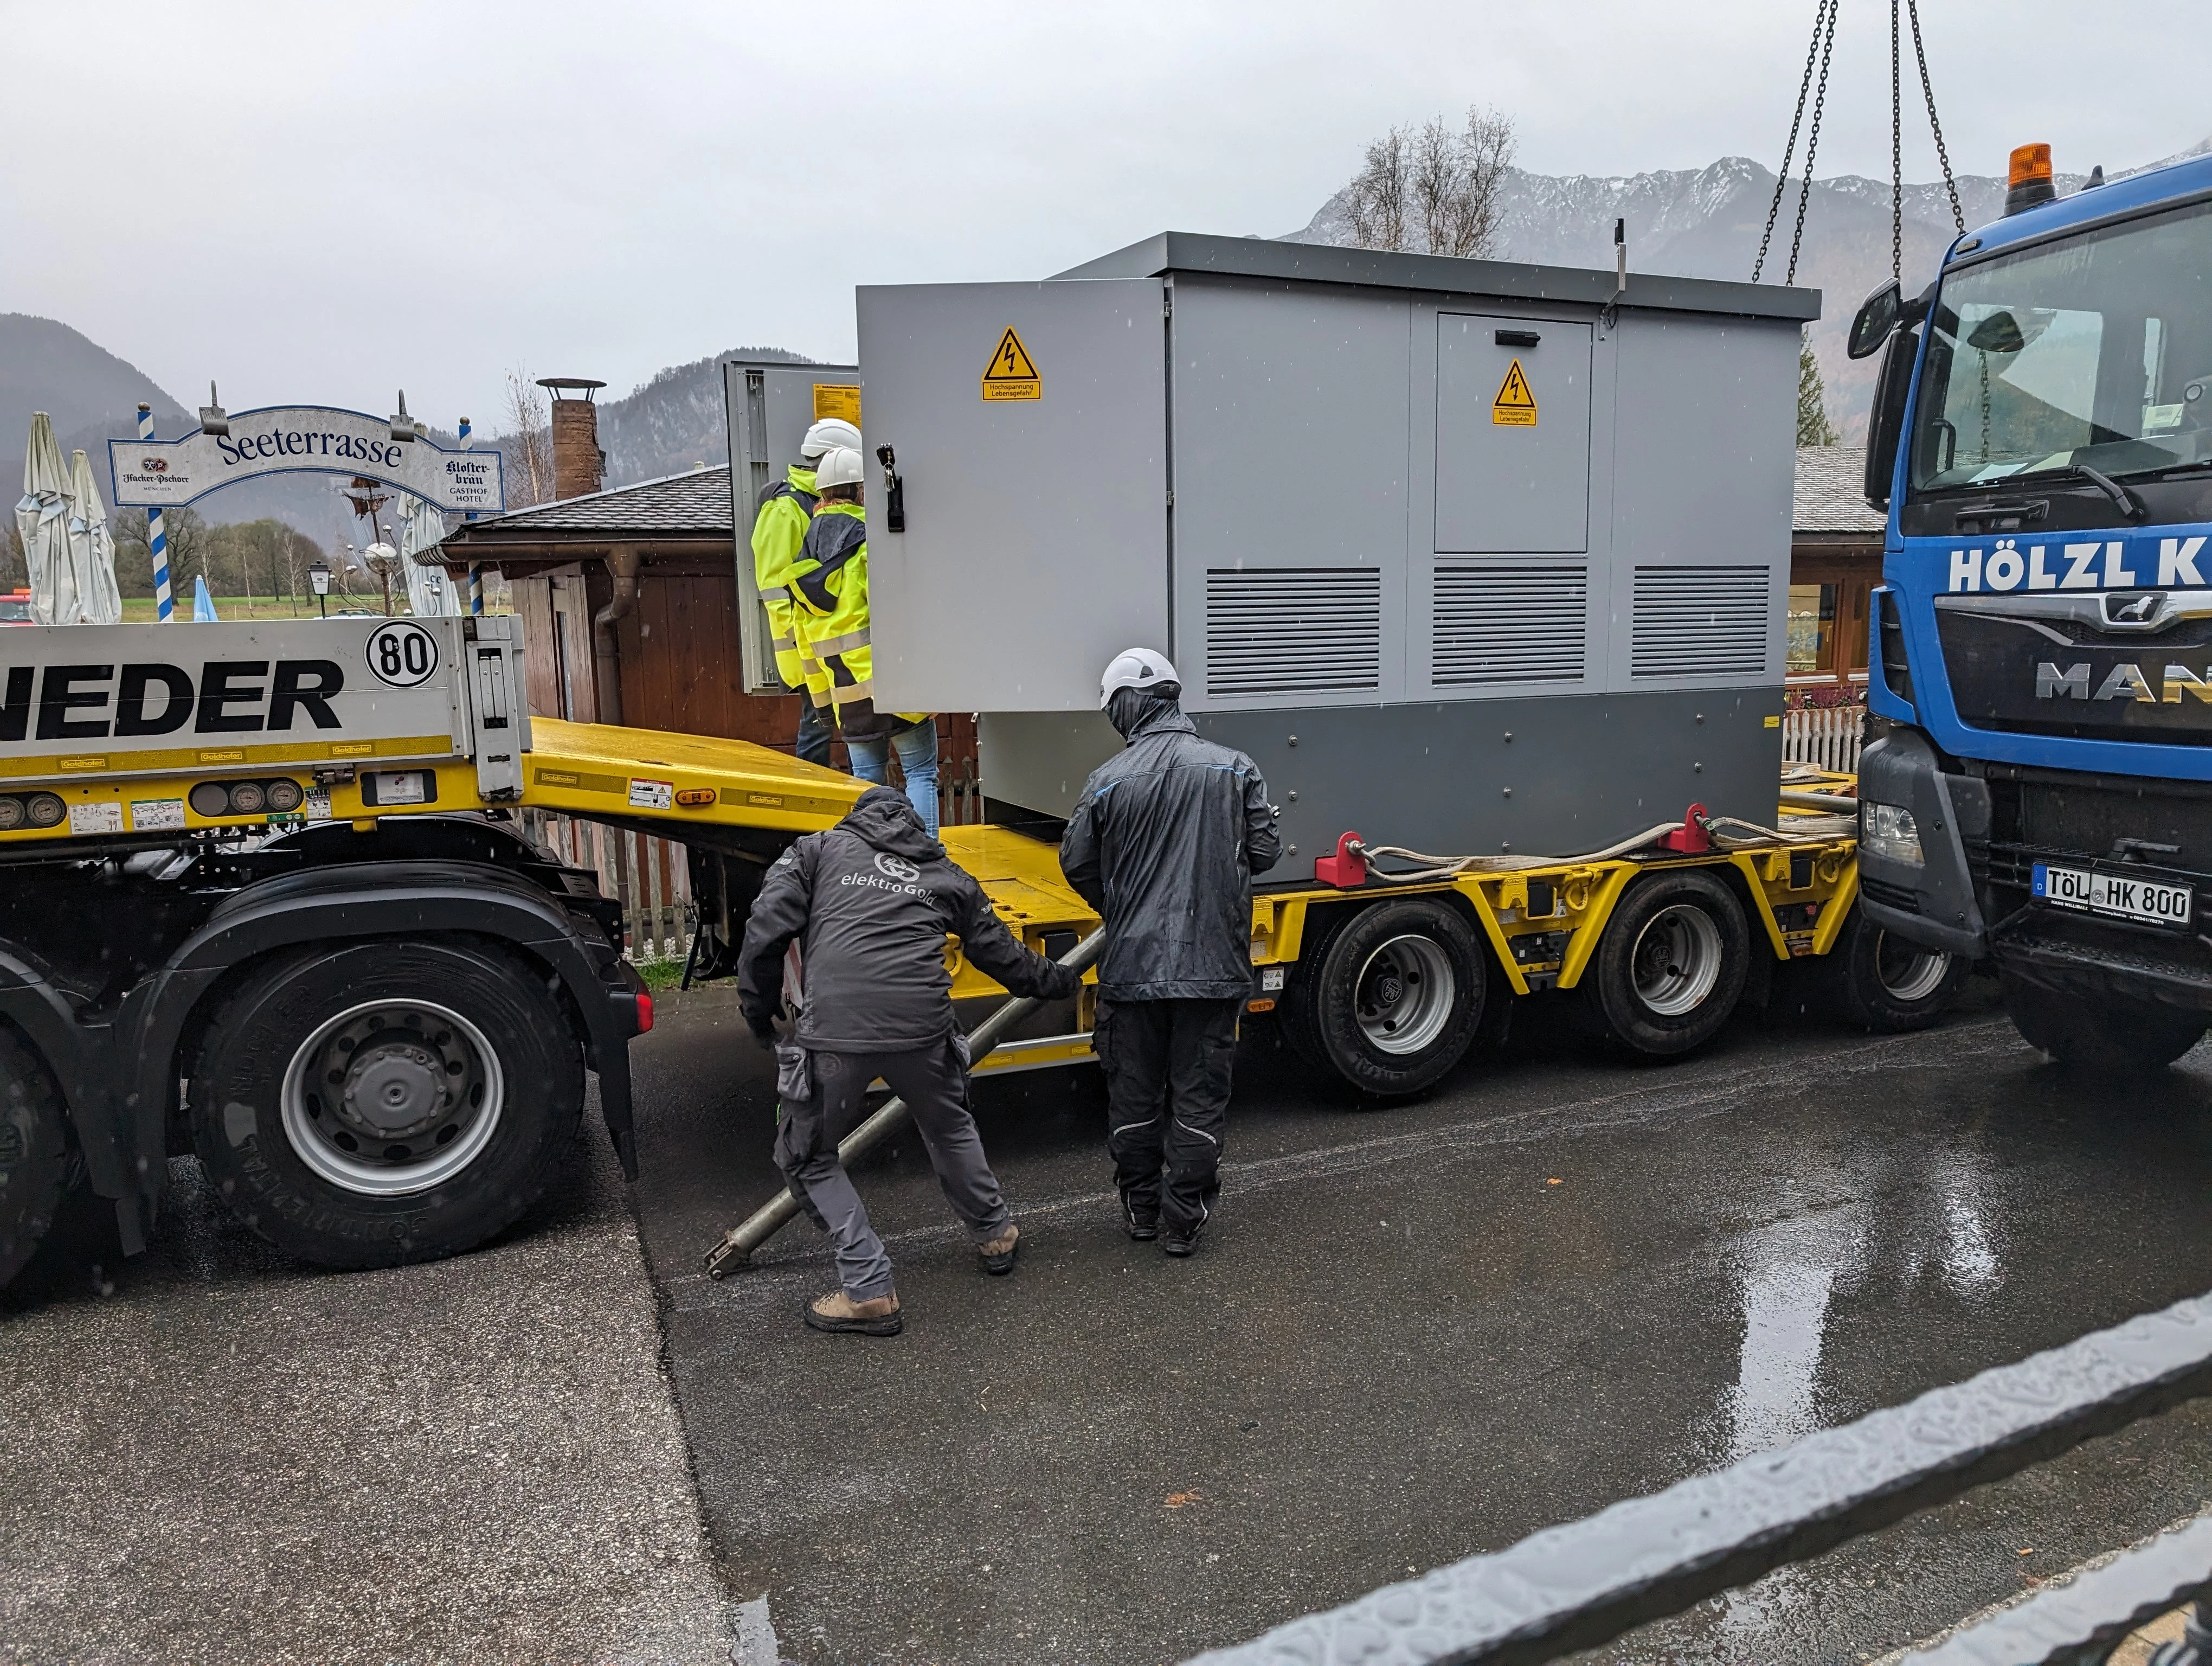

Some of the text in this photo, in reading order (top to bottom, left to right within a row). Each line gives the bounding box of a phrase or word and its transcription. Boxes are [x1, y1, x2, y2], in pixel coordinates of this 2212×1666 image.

[1499, 410, 1532, 418] Hochspannung
[216, 427, 402, 468] Seeterrasse
[123, 473, 189, 485] Hacker-Pschorr
[455, 473, 484, 485] bräu
[1949, 536, 2208, 592] HÖLZL K
[378, 632, 429, 676] 80
[2035, 662, 2212, 703] MAN
[543, 774, 576, 783] Goldhofer
[750, 797, 781, 805] Goldhofer
[2048, 870, 2187, 917] TÖL HK 800
